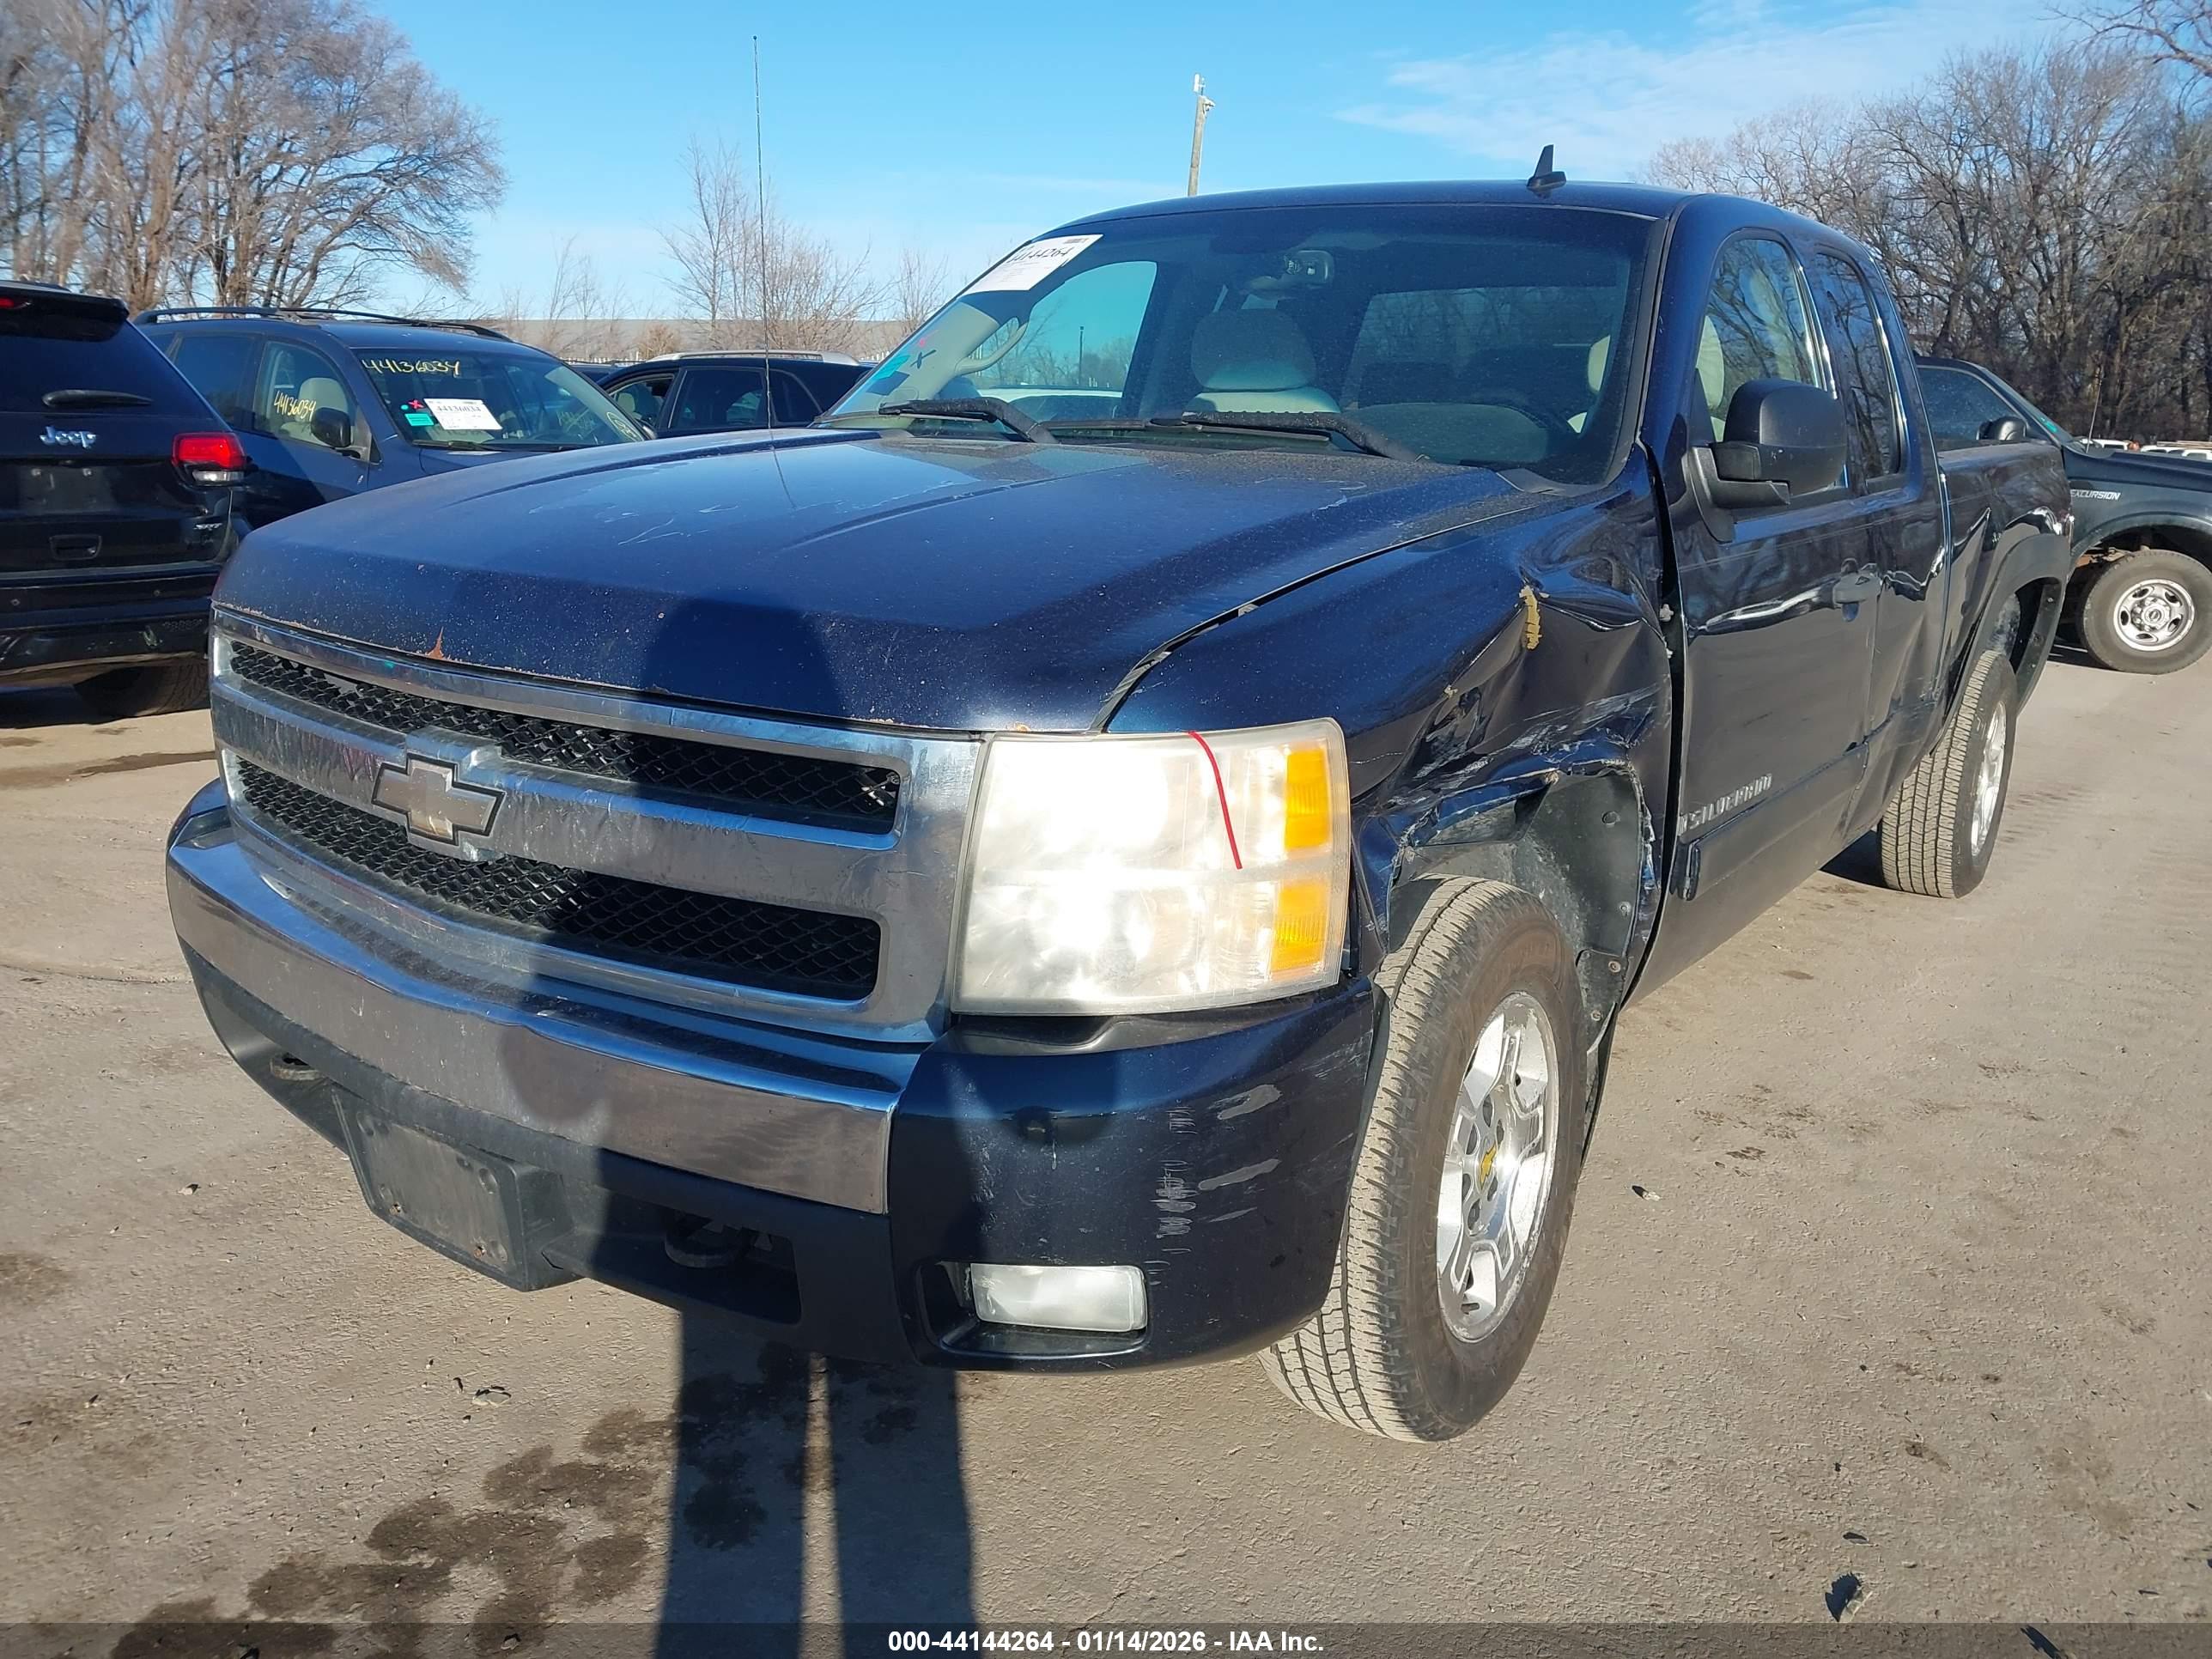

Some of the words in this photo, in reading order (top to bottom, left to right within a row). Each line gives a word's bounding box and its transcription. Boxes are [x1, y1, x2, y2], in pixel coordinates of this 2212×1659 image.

[362, 359, 460, 376] 44136034
[274, 390, 317, 422] 44136034
[40, 426, 96, 448] Jeep
[2069, 489, 2121, 500] EXCURSION
